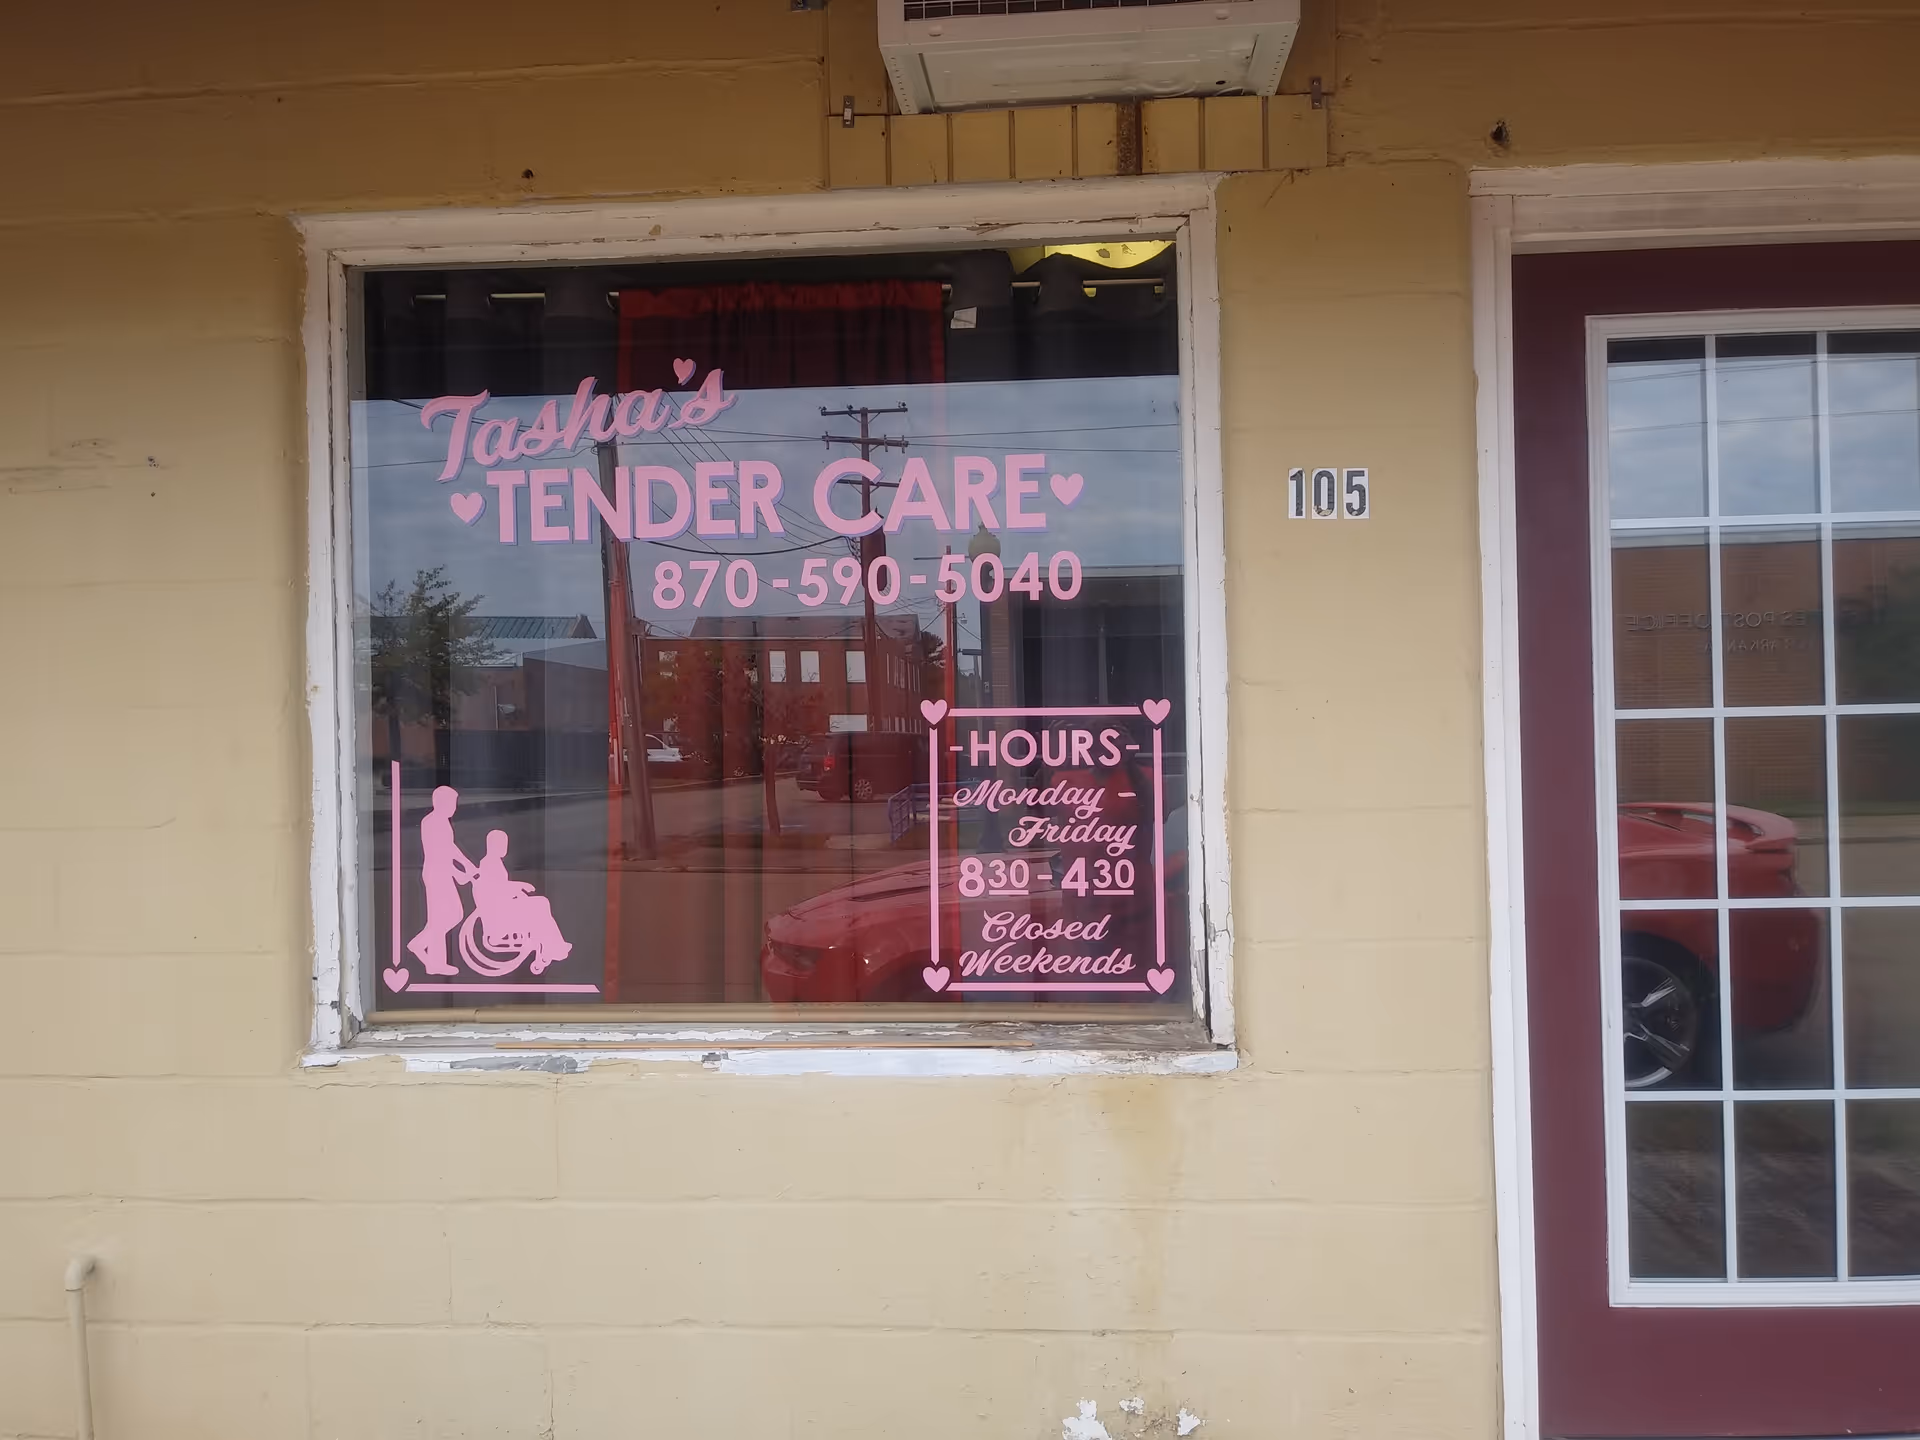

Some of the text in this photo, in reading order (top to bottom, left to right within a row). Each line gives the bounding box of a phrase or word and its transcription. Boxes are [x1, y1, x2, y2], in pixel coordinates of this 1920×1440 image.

[420, 357, 737, 483] Tasha's
[486, 453, 1048, 545] TENDER CARE
[1288, 468, 1369, 519] 105
[653, 550, 1083, 610] 870-590-5040
[953, 779, 1106, 820] Monday
[1008, 816, 1138, 857] Friday
[981, 910, 1112, 942] Closed
[958, 942, 1137, 977] Weekends
